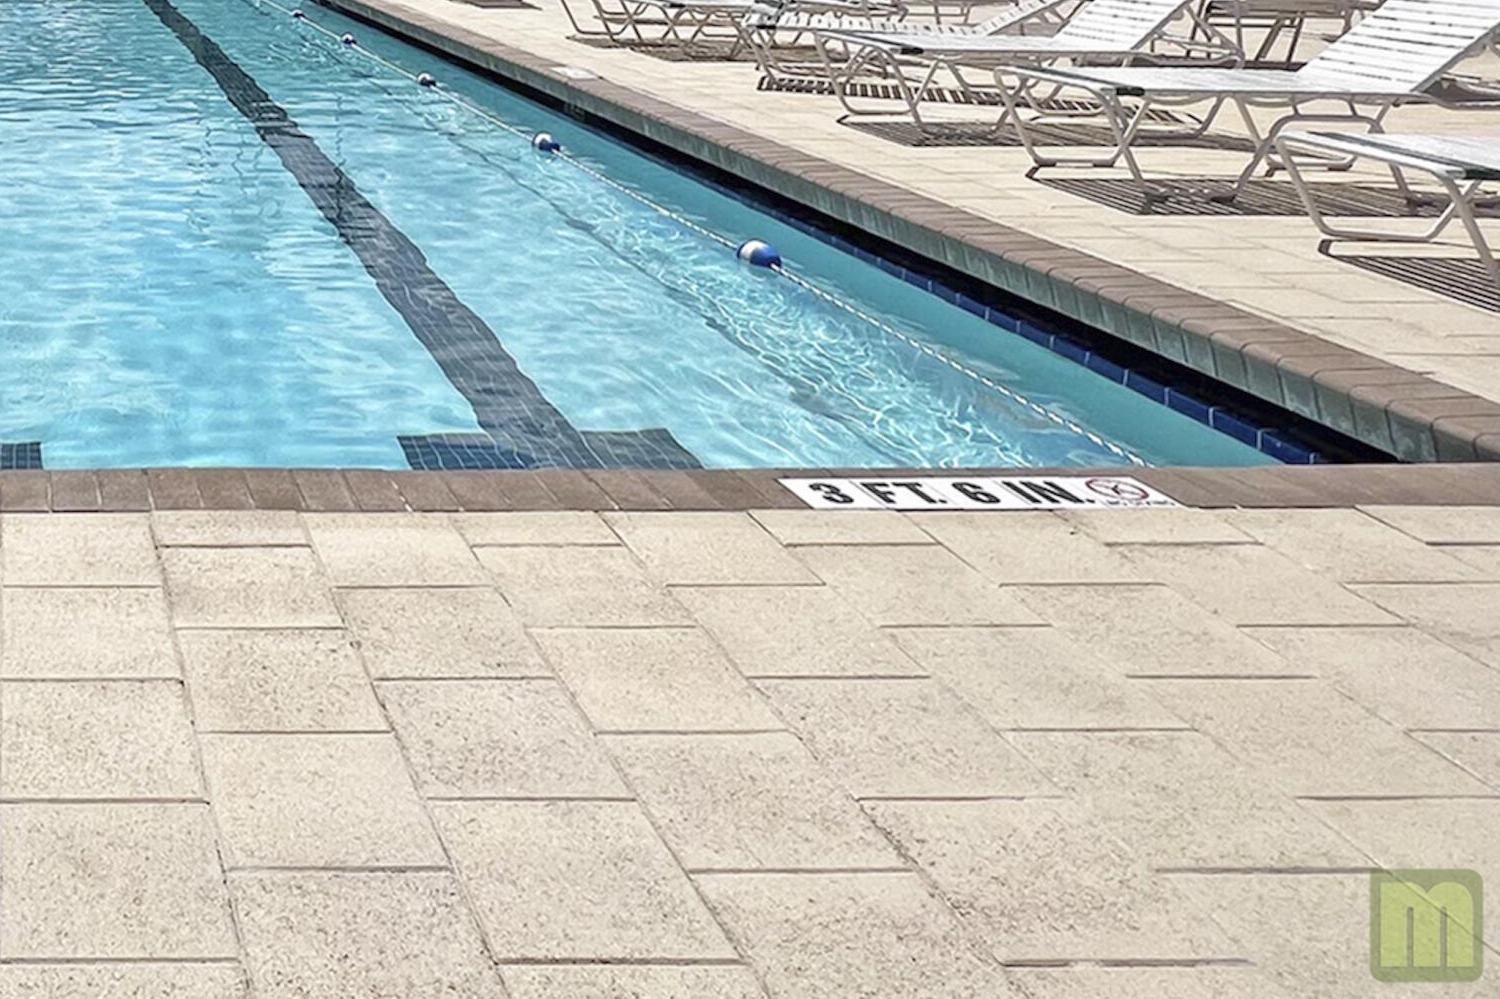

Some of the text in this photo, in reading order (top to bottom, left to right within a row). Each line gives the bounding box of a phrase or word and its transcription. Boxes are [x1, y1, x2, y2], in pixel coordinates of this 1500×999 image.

[808, 480, 1095, 504] 3 FT. 6 IN.
